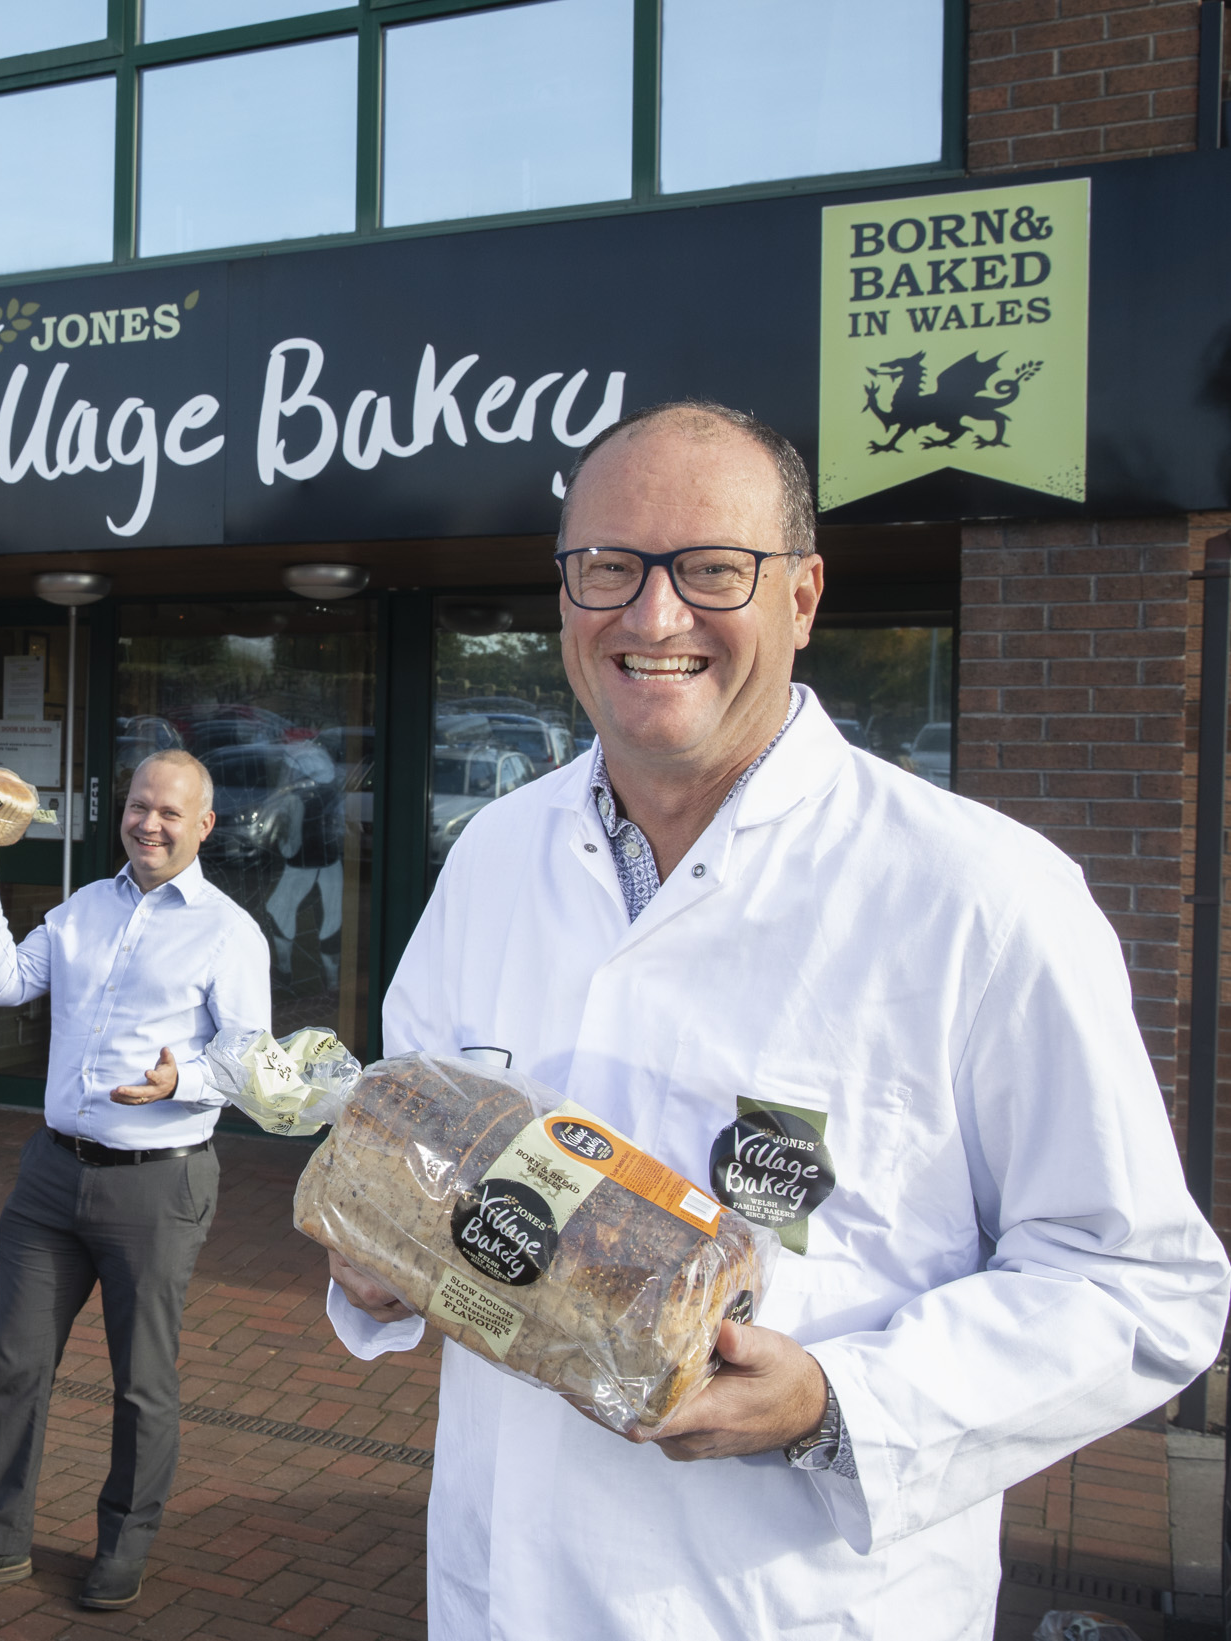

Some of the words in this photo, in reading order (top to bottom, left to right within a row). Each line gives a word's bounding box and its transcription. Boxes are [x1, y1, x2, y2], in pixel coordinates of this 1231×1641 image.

[849, 251, 1051, 302] BAKED
[30, 304, 181, 352] JONES
[848, 310, 890, 338] IN
[906, 297, 1051, 333] WALES
[257, 337, 626, 500] Bakery
[735, 1127, 819, 1184] Village
[773, 1135, 815, 1152] JONES
[515, 1148, 541, 1170] BORN
[540, 1165, 548, 1174] &
[549, 1168, 580, 1194] BREAD
[526, 1164, 536, 1174] IN
[537, 1171, 563, 1192] WALES
[725, 1162, 808, 1211] Bakery
[479, 1185, 541, 1256] Village
[513, 1205, 547, 1231] JONES
[733, 1202, 762, 1212] FAMILY
[763, 1207, 796, 1219] BAKERS
[745, 1211, 766, 1219] SINCE
[750, 1198, 778, 1208] WELSH
[461, 1217, 525, 1279] Bakery
[477, 1251, 501, 1270] WELSH
[440, 1289, 454, 1301] for
[456, 1299, 511, 1335] Outstanding
[444, 1284, 470, 1304] rising
[471, 1300, 514, 1325] naturally
[450, 1275, 477, 1296] SLOW
[478, 1293, 514, 1320] DOUGH
[443, 1300, 502, 1339] FLAVOUR
